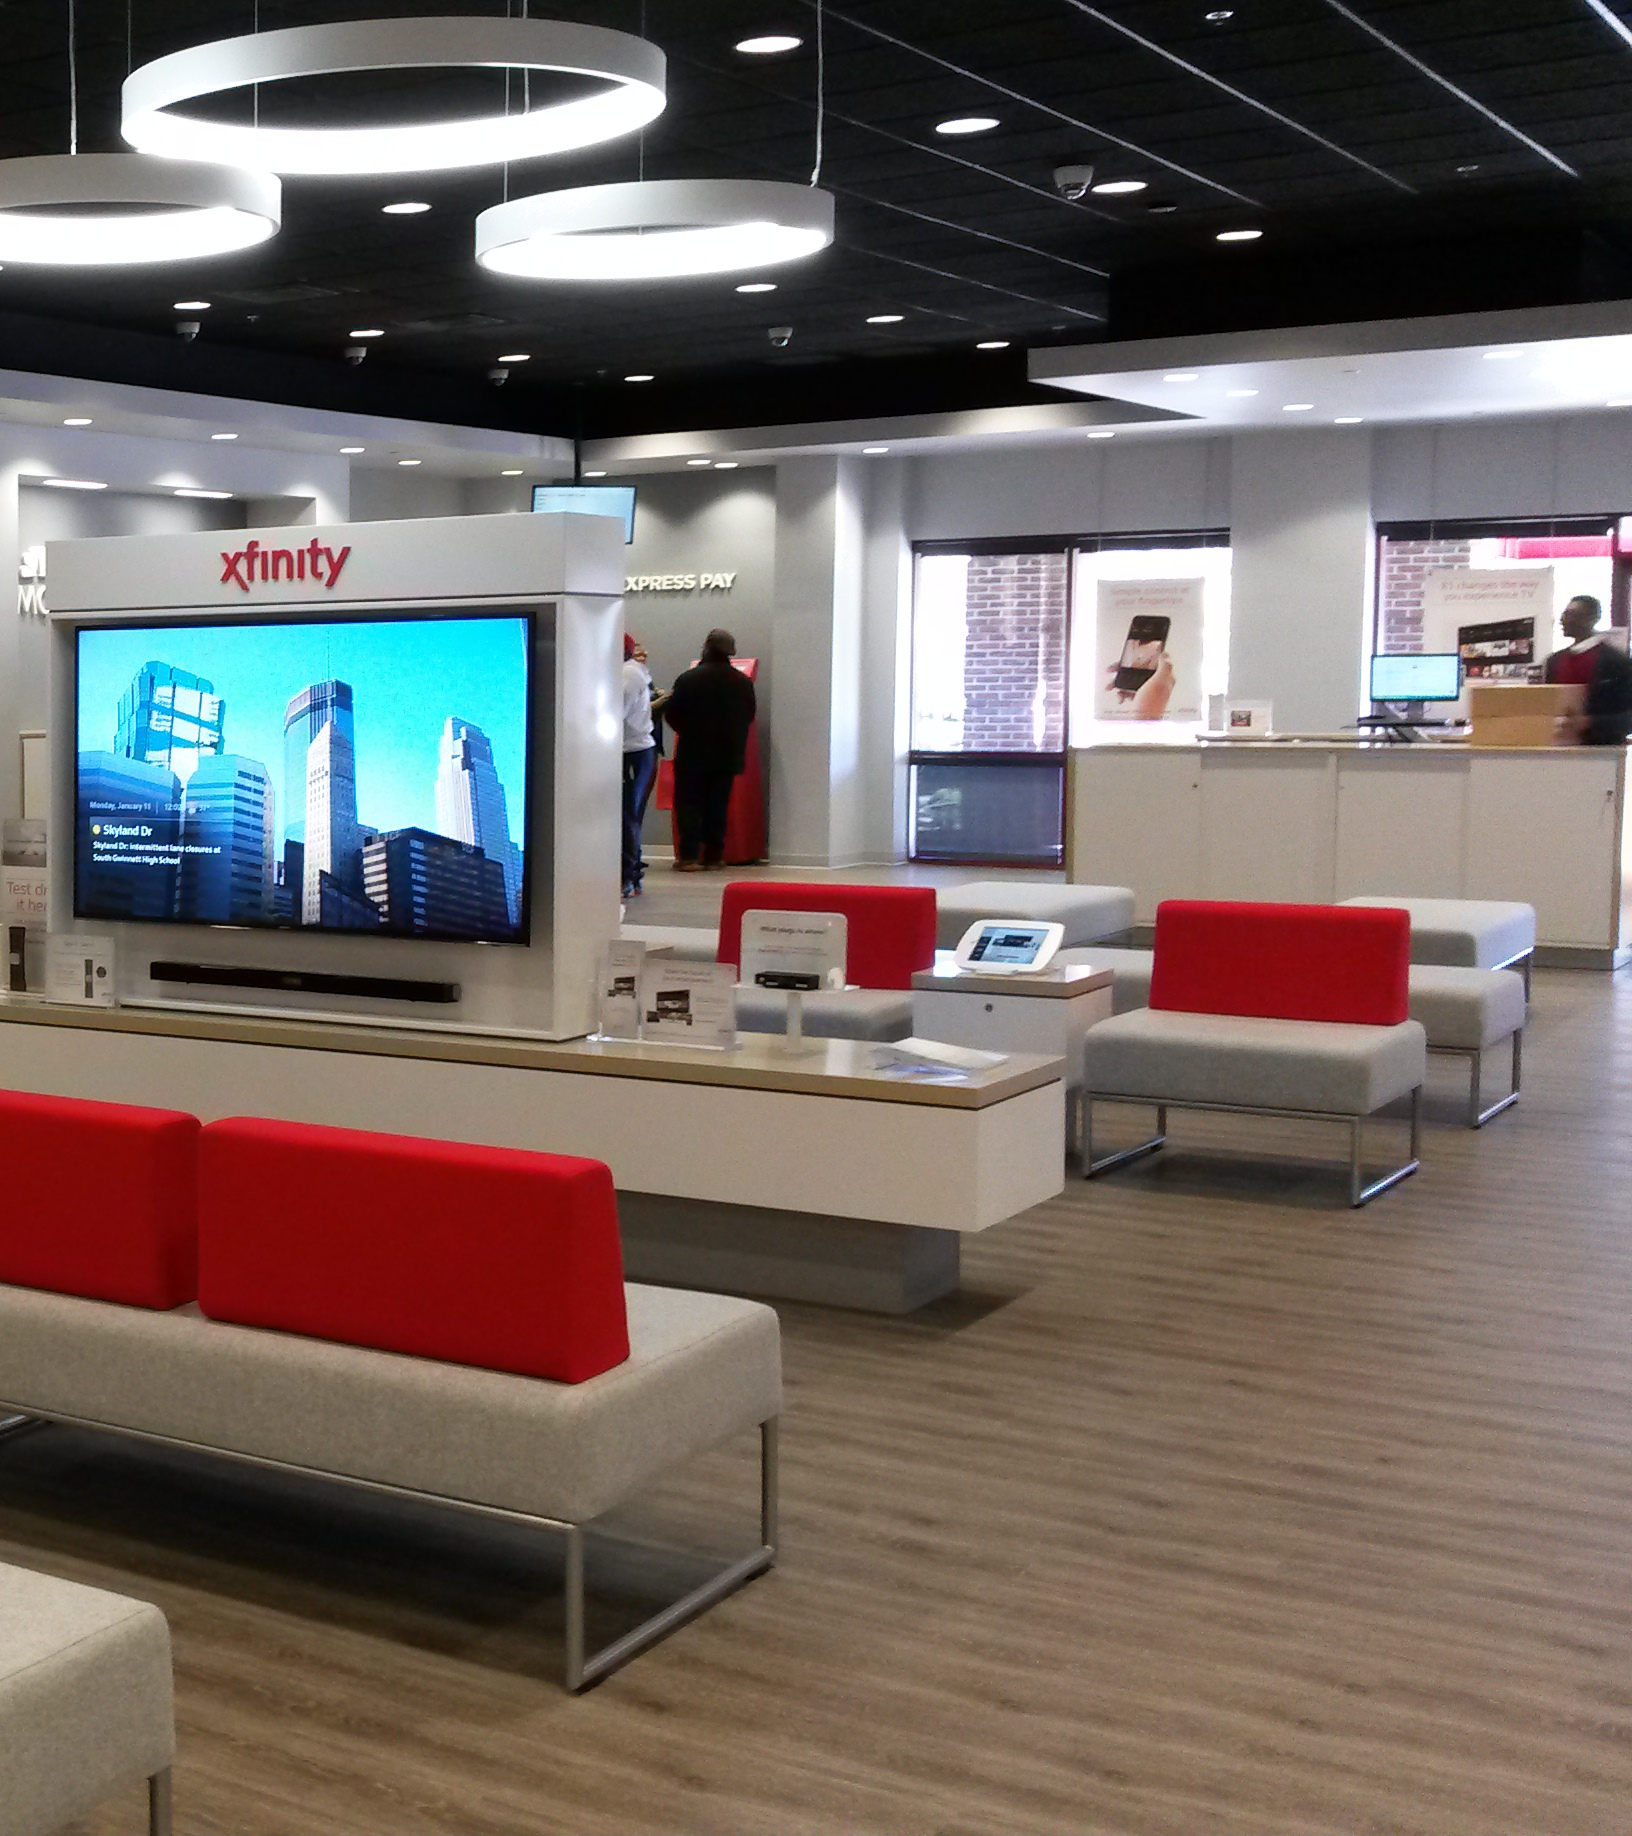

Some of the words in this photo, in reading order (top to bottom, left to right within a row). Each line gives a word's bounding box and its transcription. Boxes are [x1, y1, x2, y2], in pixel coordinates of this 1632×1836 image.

[220, 538, 351, 591] xfinity
[625, 573, 697, 591] XPRESS
[700, 572, 737, 590] PAY
[103, 825, 140, 838] Skyland
[140, 826, 153, 837] Dr
[93, 841, 118, 851] Skyland
[130, 843, 169, 852] intermittent
[170, 844, 184, 852] lane
[185, 845, 213, 853] closures
[213, 846, 222, 854] at
[93, 853, 112, 862] South
[142, 855, 158, 866] High
[159, 856, 180, 865] School
[6, 881, 31, 896] Test
